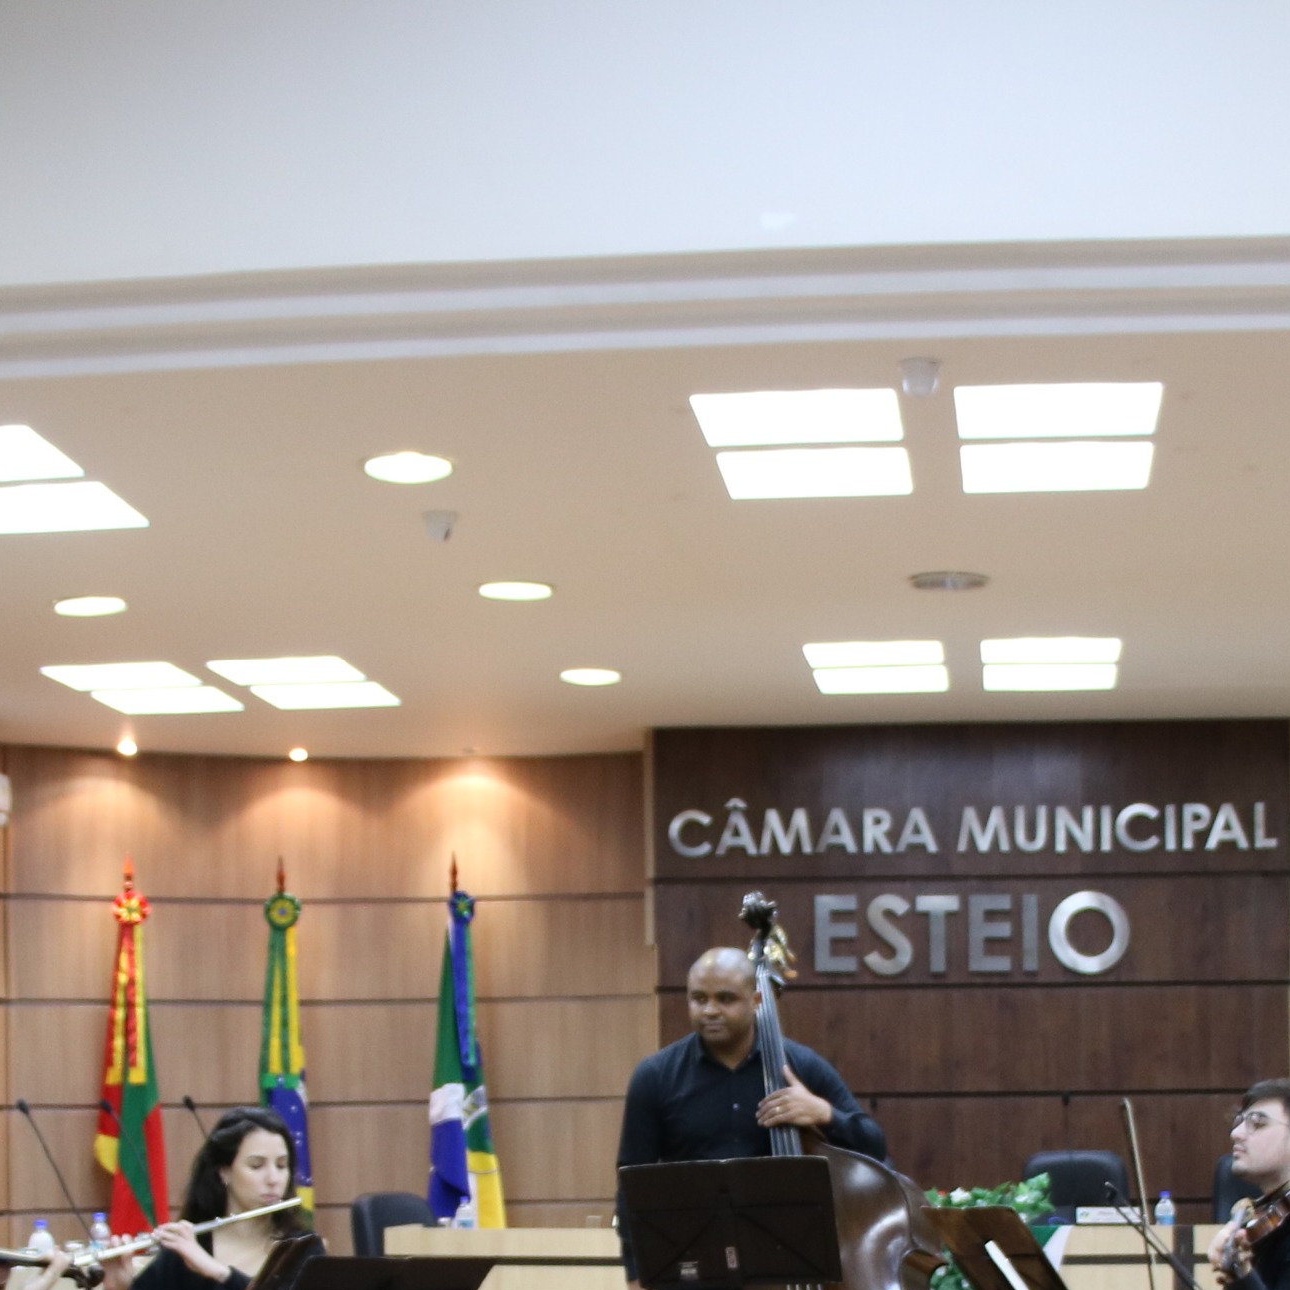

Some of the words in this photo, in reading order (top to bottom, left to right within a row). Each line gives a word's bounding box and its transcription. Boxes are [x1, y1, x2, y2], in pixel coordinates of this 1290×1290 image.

[668, 798, 938, 857] CÂMARA
[957, 802, 1277, 853] MUNICIPAL
[814, 890, 1130, 975] ESTEIO
